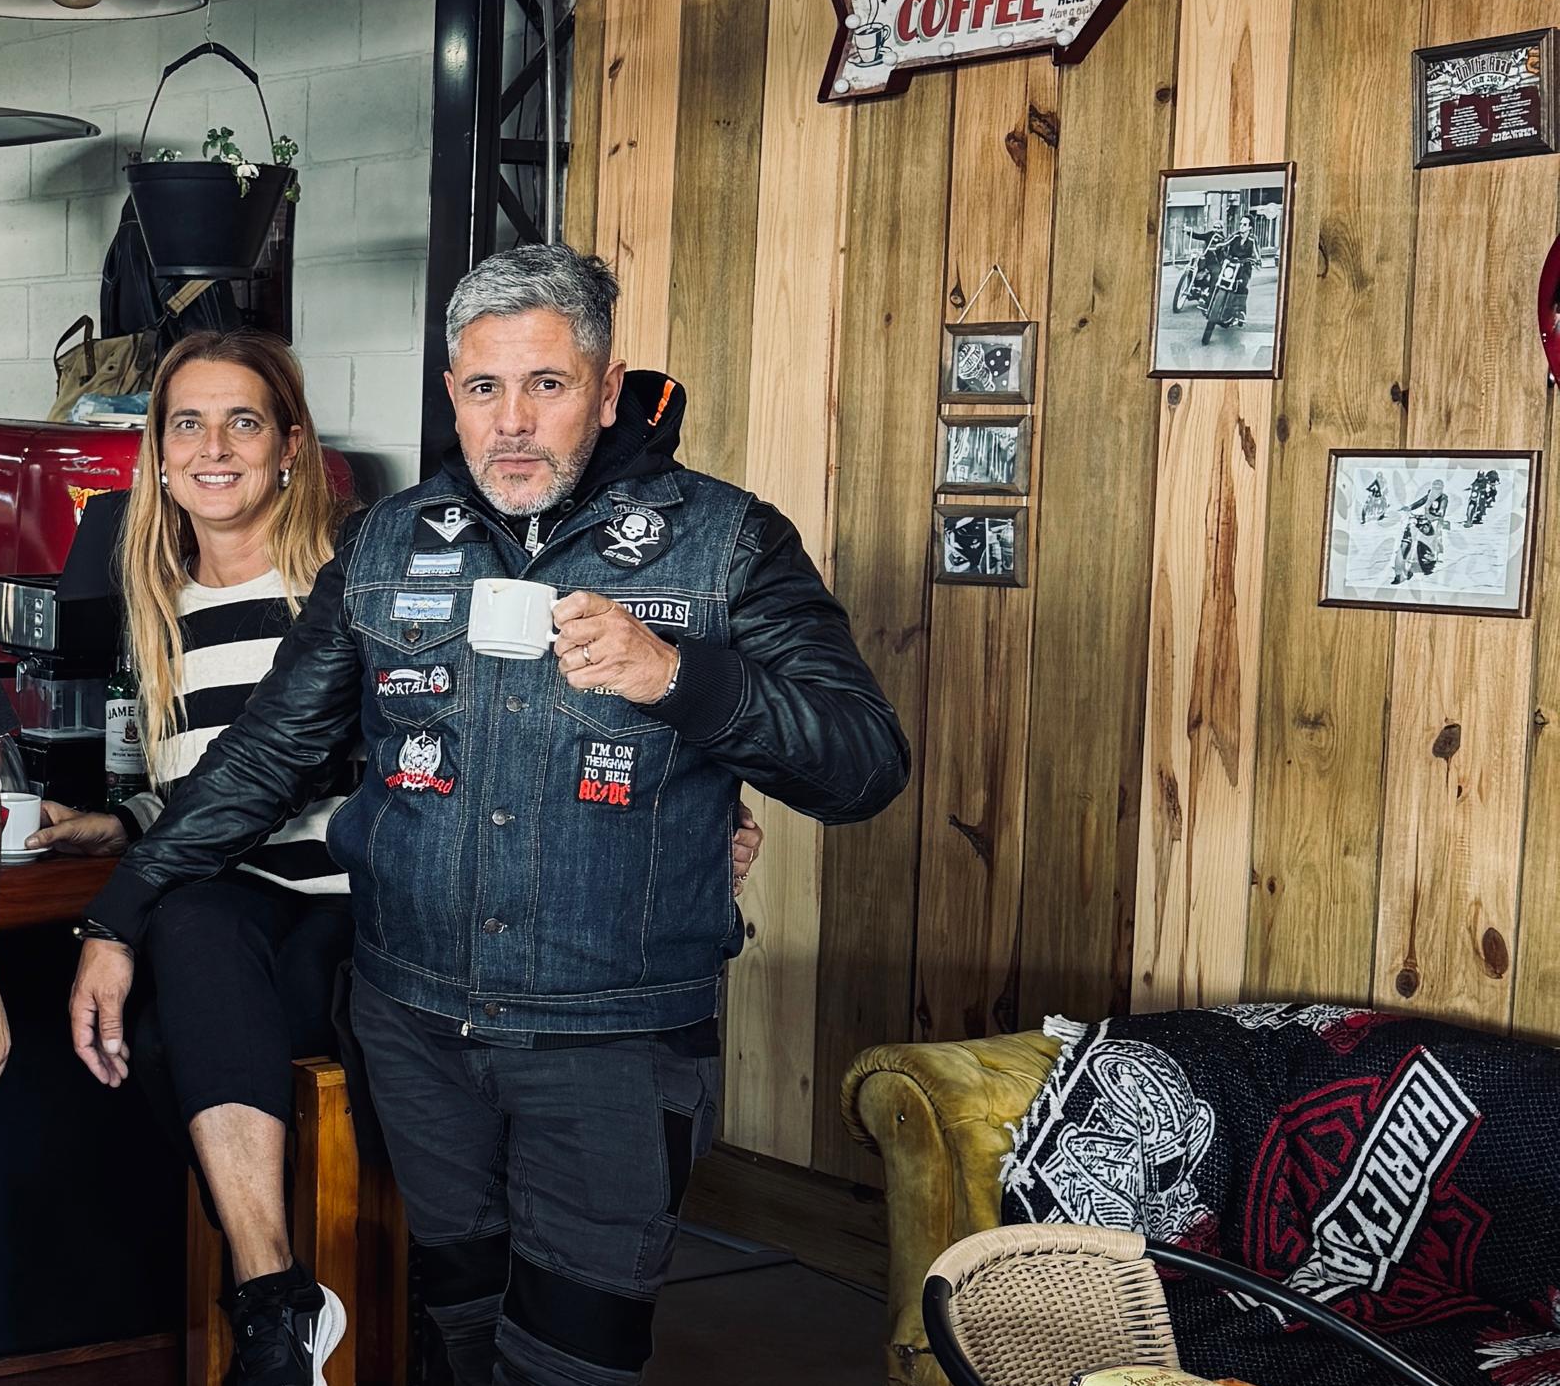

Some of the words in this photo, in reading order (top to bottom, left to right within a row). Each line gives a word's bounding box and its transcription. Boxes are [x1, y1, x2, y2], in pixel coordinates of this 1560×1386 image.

[377, 678, 430, 696] MORTAL
[591, 743, 610, 756] I'M
[615, 746, 634, 759] ON
[584, 767, 599, 780] TO
[604, 771, 631, 784] HELL
